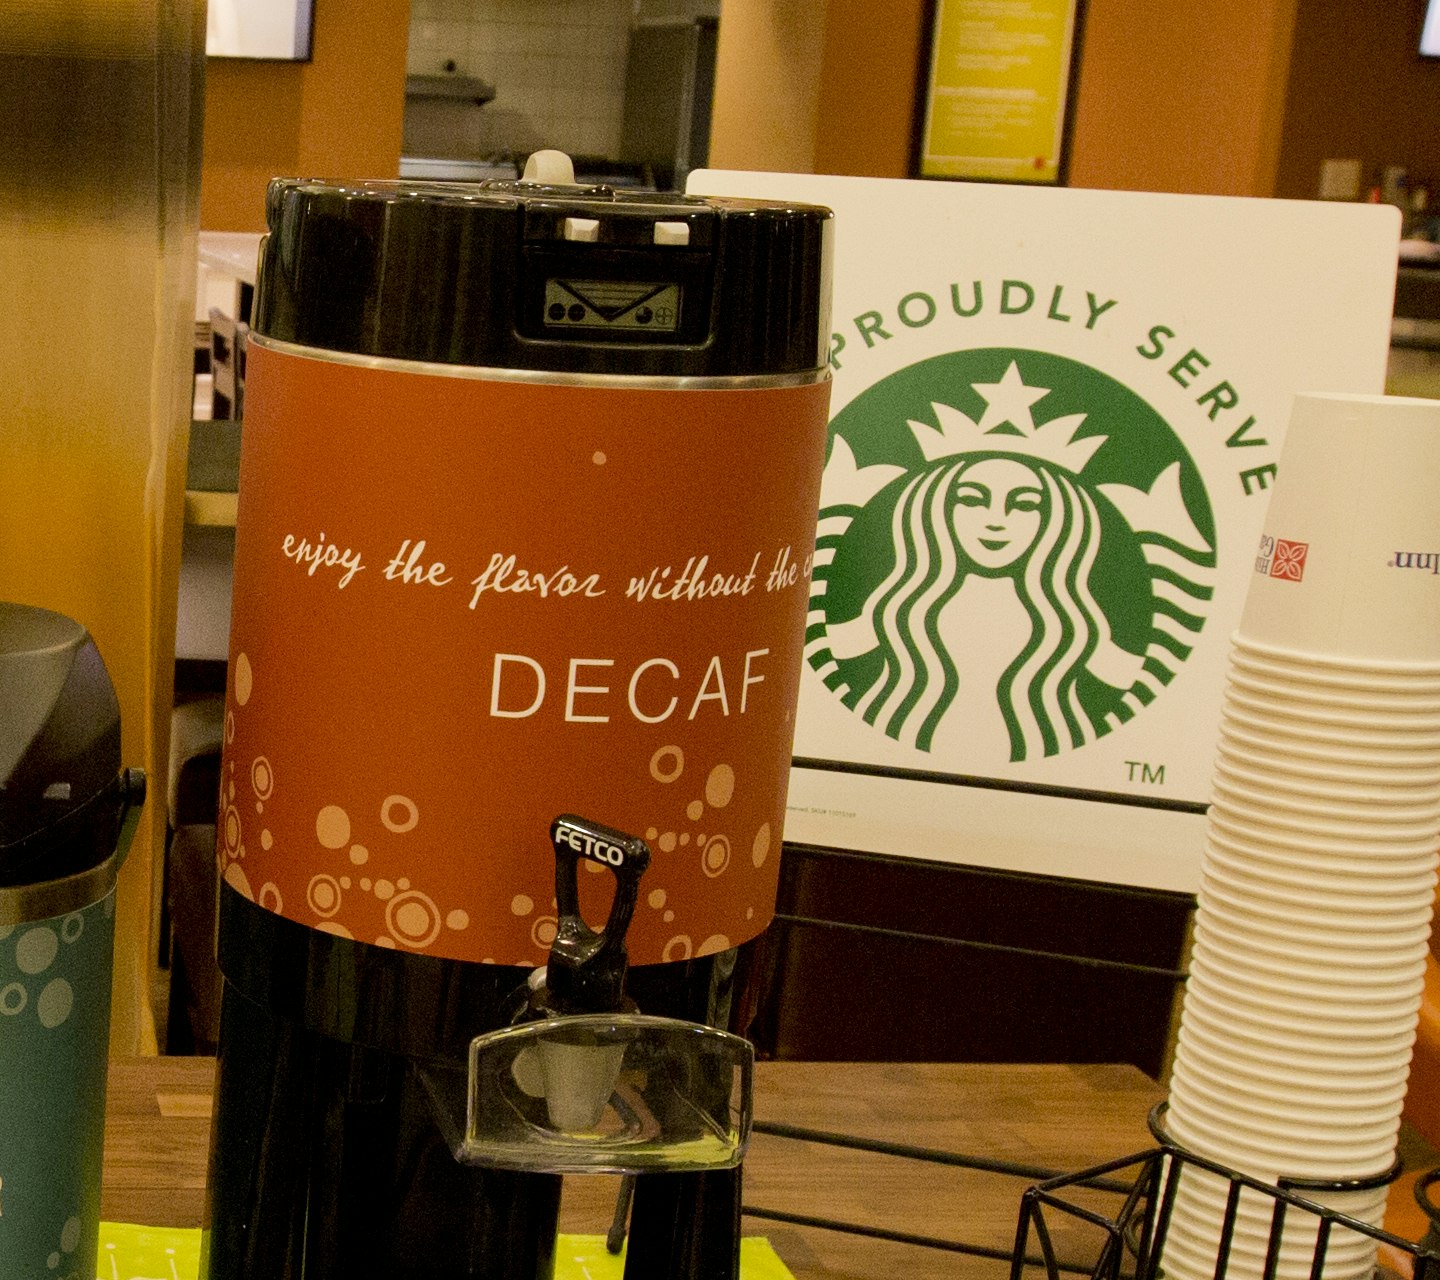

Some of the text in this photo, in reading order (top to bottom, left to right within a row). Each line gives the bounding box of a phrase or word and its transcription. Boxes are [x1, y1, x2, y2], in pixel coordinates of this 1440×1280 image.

[830, 278, 1279, 498] PROUDLY SERVE
[281, 531, 366, 590] enjoy
[382, 538, 454, 587] the
[468, 552, 607, 611] flavor
[625, 551, 762, 603] without
[765, 544, 799, 593] the
[489, 647, 770, 724] DECAF
[1123, 760, 1166, 786] TM
[555, 826, 625, 867] FETCO
